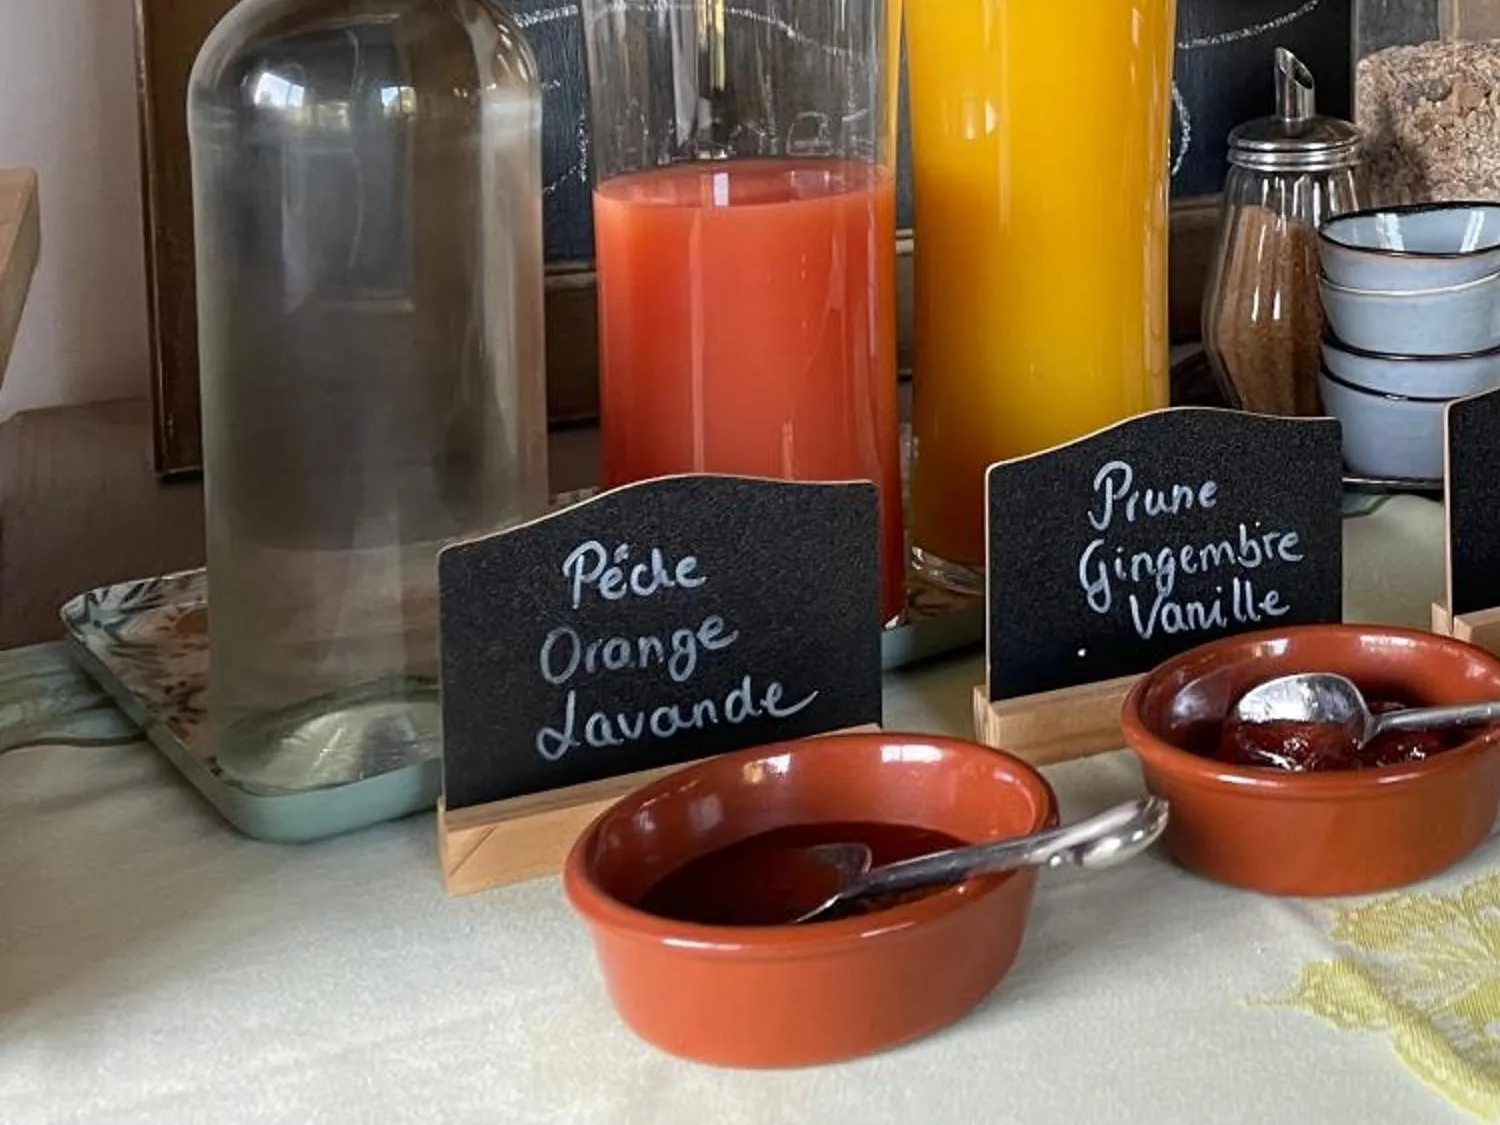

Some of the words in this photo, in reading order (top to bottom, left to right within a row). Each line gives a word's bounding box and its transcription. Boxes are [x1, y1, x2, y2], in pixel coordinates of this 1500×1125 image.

[1087, 460, 1218, 531] Prune
[1079, 521, 1304, 614] Gingembre
[1129, 577, 1290, 640] Vanille
[539, 614, 740, 685] Orange
[535, 674, 820, 761] Lavande
